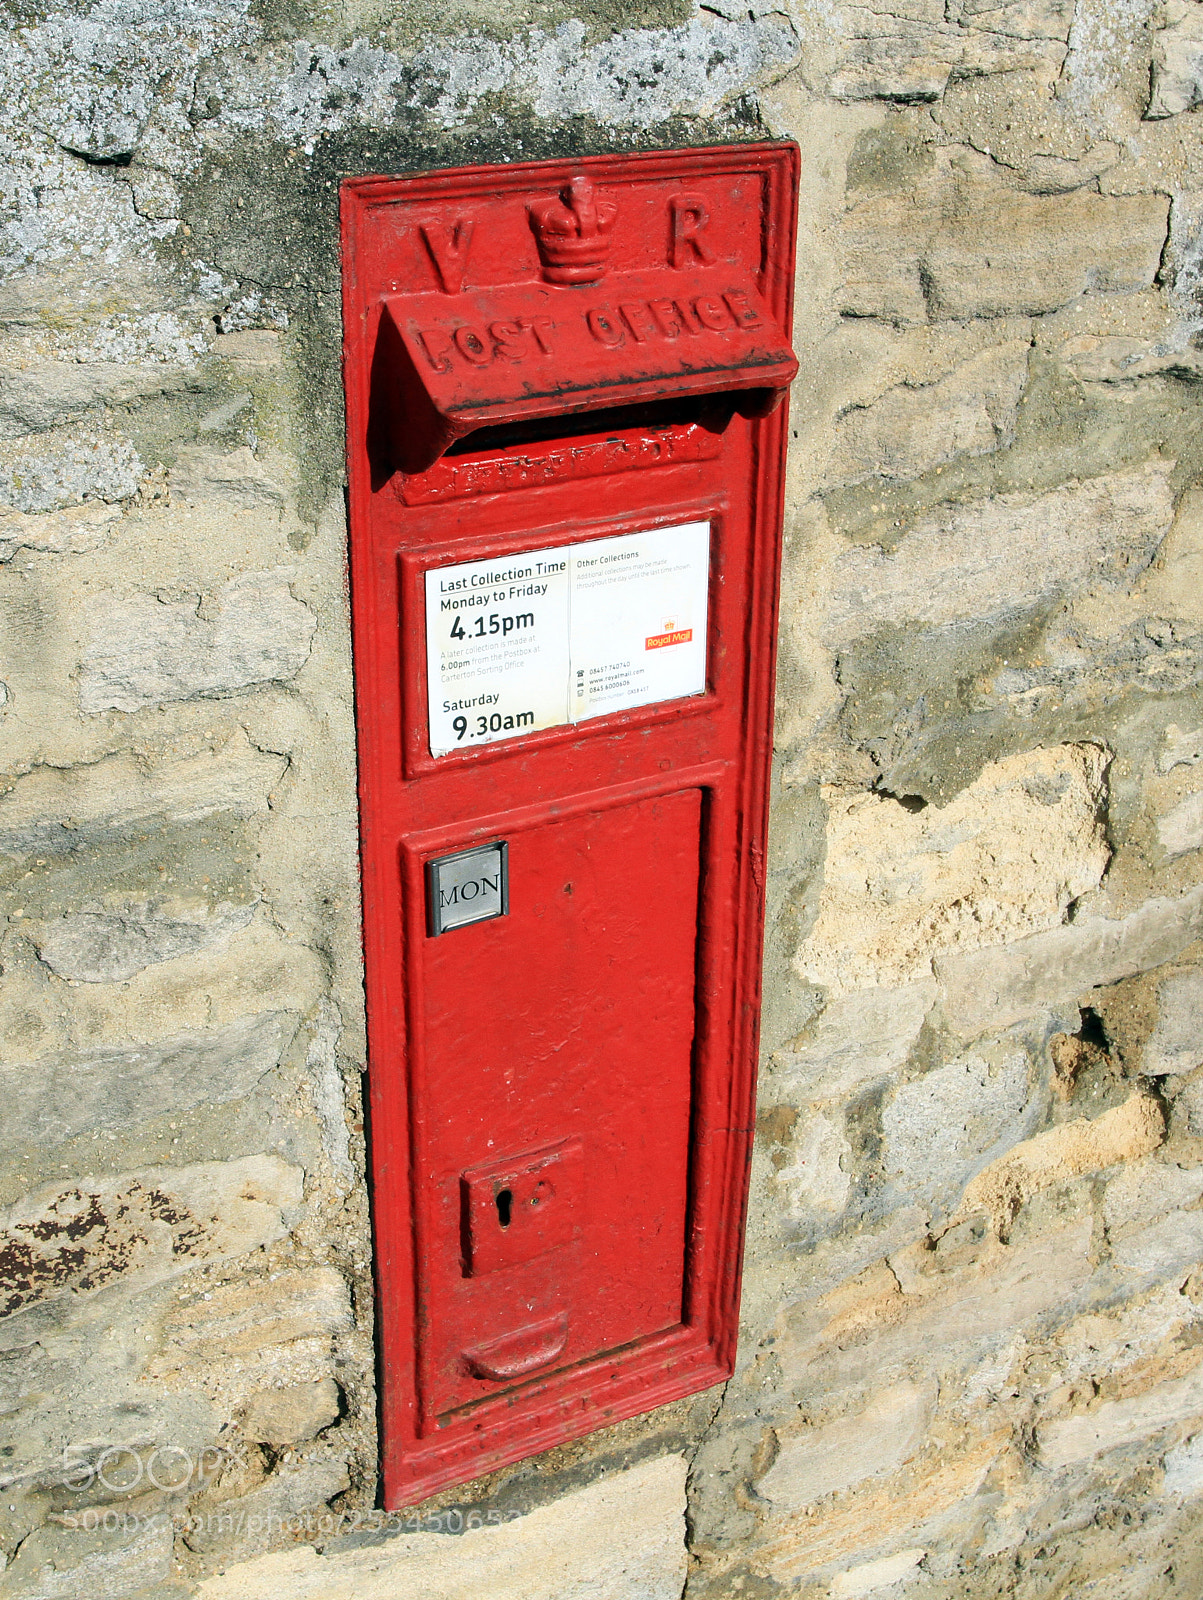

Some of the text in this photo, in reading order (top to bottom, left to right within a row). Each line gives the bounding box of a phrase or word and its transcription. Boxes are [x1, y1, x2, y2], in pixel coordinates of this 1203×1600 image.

[420, 192, 716, 296] V R
[417, 291, 764, 374] POST OFFICE
[577, 551, 639, 568] Other Collections
[440, 561, 566, 593] Last Collection Time
[577, 569, 604, 580] Additional
[604, 565, 632, 575] collections
[632, 563, 644, 571] may
[577, 578, 607, 590] throughout
[608, 576, 617, 584] the
[660, 566, 672, 574] time
[440, 583, 548, 612] Monday to Friday
[450, 612, 534, 640] 4.15pm
[440, 651, 446, 659] A
[446, 648, 464, 658] later
[465, 642, 499, 655] collection
[507, 637, 528, 646] made
[647, 631, 691, 647] Royal Mail
[440, 645, 541, 672] 6.00pm from the Postbox at
[589, 661, 631, 675] 08457 740740
[440, 660, 525, 683] Carterton Sorting Office
[589, 668, 645, 685] www.royalmail.com
[589, 685, 604, 694] 0845
[443, 693, 500, 713] Saturday
[452, 710, 535, 741] 9.30am
[440, 873, 500, 908] MON
